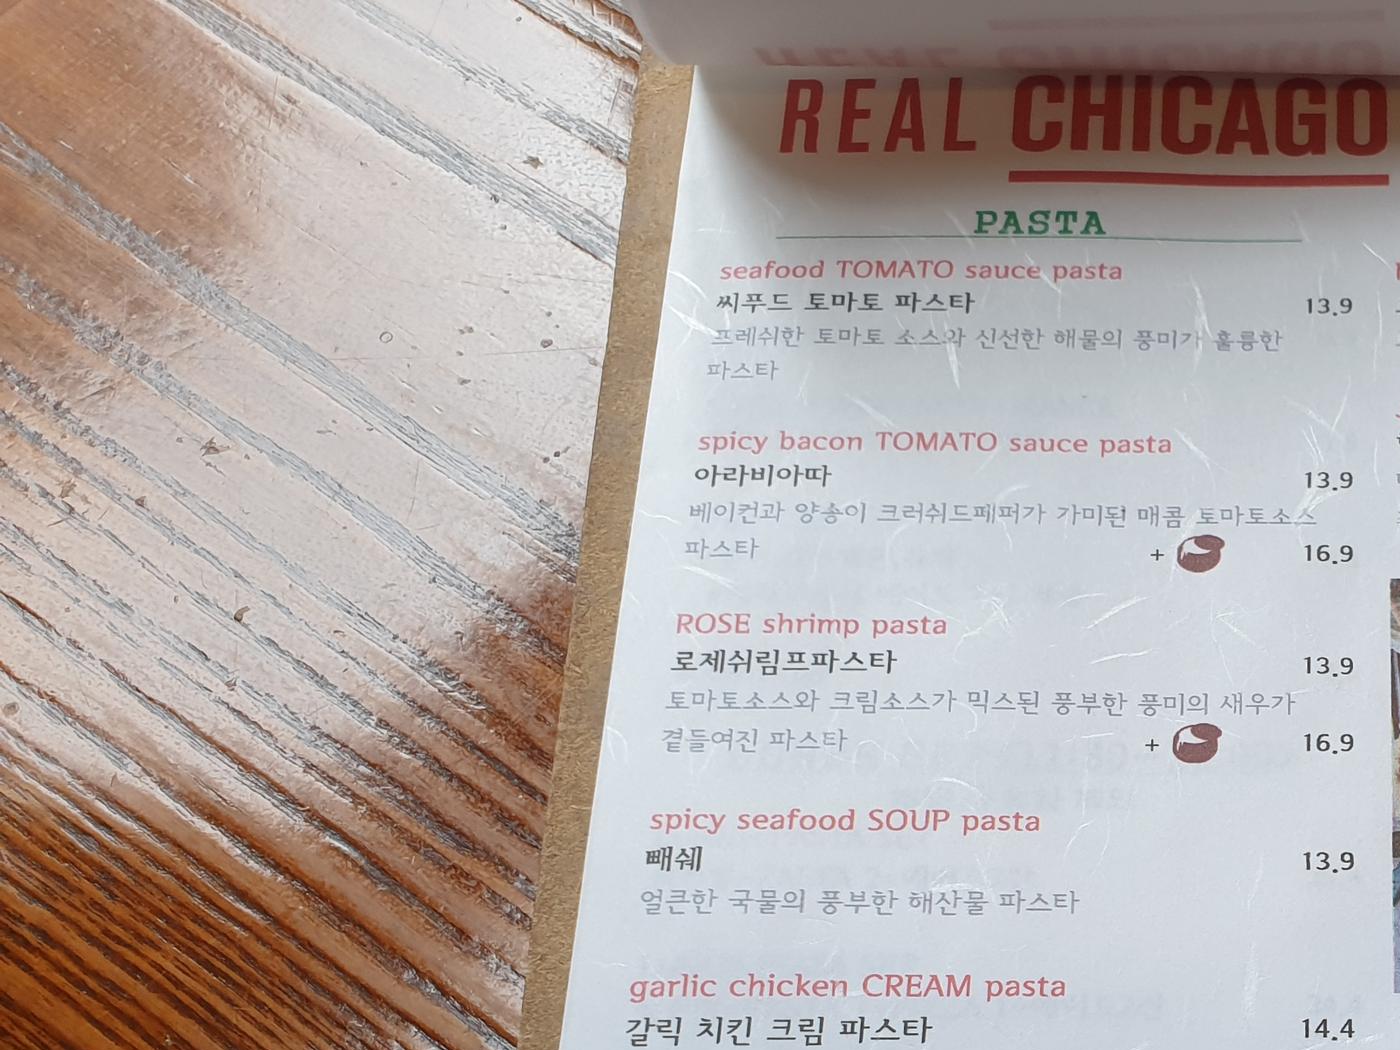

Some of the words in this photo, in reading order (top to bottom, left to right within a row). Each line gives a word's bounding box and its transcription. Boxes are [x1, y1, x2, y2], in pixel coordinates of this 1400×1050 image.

[780, 77, 976, 154] REAL
[1010, 74, 1389, 156] CHICAGO
[973, 210, 1107, 236] PASTA
[719, 259, 825, 281] seafood
[835, 259, 954, 279] TOMATO
[964, 264, 1041, 280] sauce
[1052, 262, 1123, 284] pasta
[716, 292, 793, 314] 씨푸드
[803, 291, 884, 313] 토마토
[894, 291, 976, 315] 파스타
[1306, 297, 1353, 317] 13.9
[697, 430, 769, 455] spicy
[779, 430, 863, 451] bacon
[875, 431, 998, 452] TOMATO
[1009, 437, 1089, 453] sauce
[1099, 435, 1172, 459] pasta
[694, 463, 833, 488] 아라비아따
[1304, 471, 1354, 492] 13.9
[1304, 544, 1354, 565] 16.9
[676, 612, 751, 634] ROSE
[762, 612, 860, 640] shrimp
[871, 615, 947, 640] pasta
[670, 648, 898, 677] 로제쉬림프파스타
[1303, 656, 1354, 678] 13.9
[664, 688, 821, 713] 토마토소스와
[829, 689, 958, 715] 크림소스가
[967, 689, 1040, 716] 믹스된
[1050, 691, 1129, 717] 풍부한
[1137, 692, 1209, 717] 풍미의
[1219, 691, 1297, 716] 새우가
[661, 727, 758, 754] 곁들여진
[768, 728, 849, 753] 파스타
[1303, 733, 1354, 755] 16.9
[649, 807, 726, 835] spicy
[736, 808, 856, 832] seafood
[867, 808, 951, 832] SOUP
[961, 811, 1040, 837] pasta
[645, 845, 704, 873] 빼쉐
[1302, 851, 1355, 874] 13.9
[629, 973, 717, 1004] garlic
[729, 972, 848, 998] chicken
[862, 973, 972, 998] CREAM
[984, 976, 1066, 1003] pasta
[625, 1016, 682, 1048] 갈릭
[696, 1015, 753, 1047] 치킨
[766, 1016, 825, 1047] 크림
[839, 1016, 934, 1045] 파스타
[1301, 1018, 1356, 1042] 14.4
